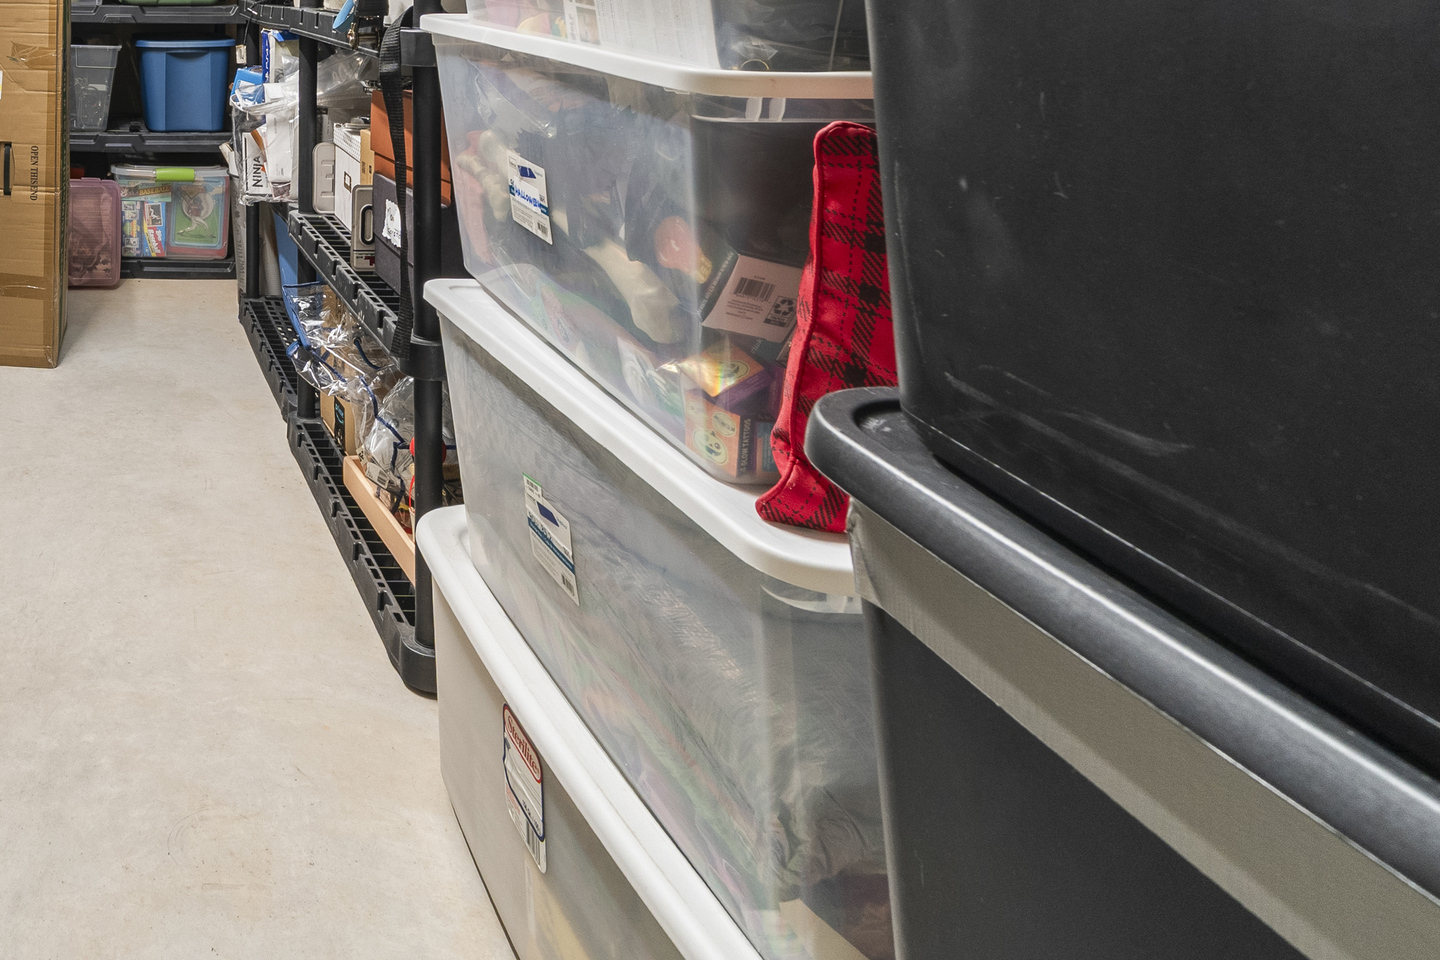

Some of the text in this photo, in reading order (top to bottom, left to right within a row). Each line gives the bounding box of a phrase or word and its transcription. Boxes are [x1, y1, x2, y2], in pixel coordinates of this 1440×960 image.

[29, 145, 39, 201] OPEN THIS END
[252, 155, 264, 188] NINJA
[139, 186, 170, 196] BASEBALL
[742, 418, 751, 447] TATTOOS
[741, 447, 749, 466] GLOW
[507, 715, 540, 775] Sterilite
